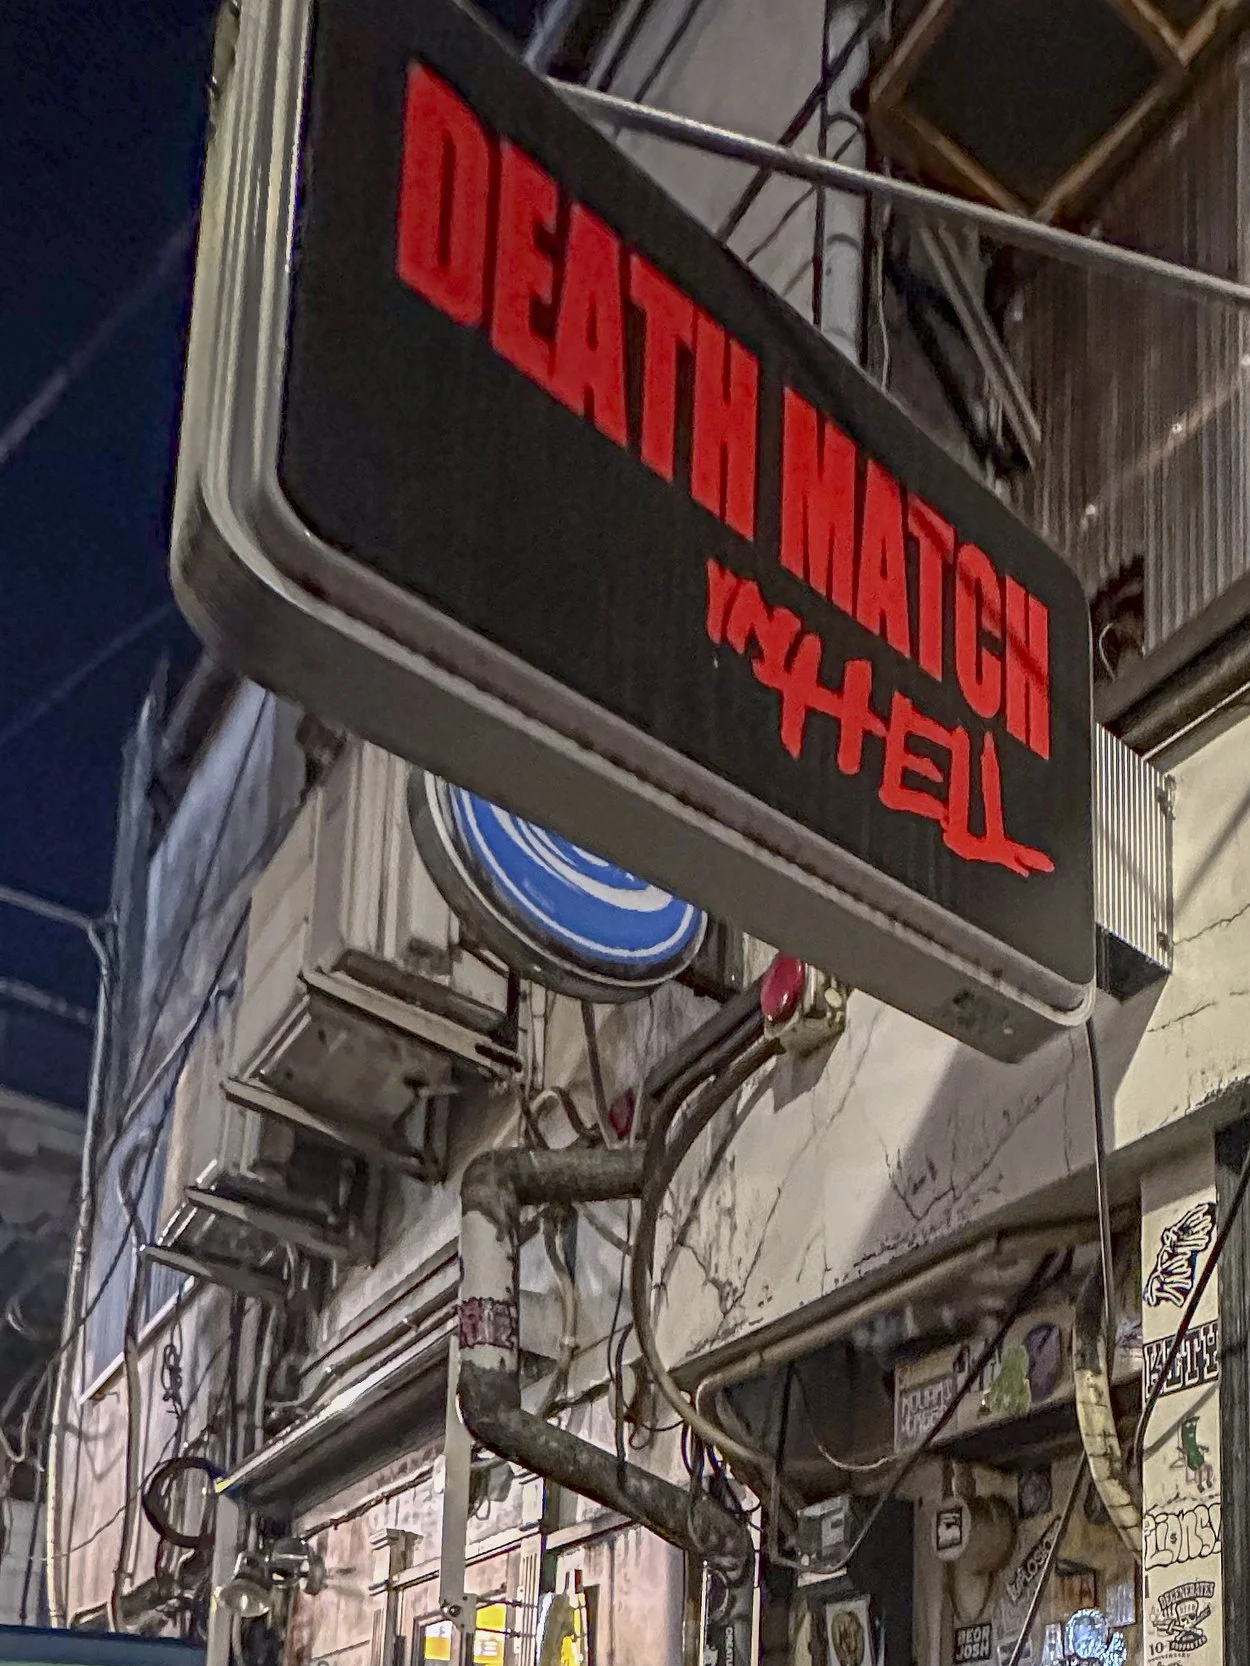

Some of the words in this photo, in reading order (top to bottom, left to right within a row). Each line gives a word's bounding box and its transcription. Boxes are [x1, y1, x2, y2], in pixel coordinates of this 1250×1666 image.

[397, 60, 760, 541] DEATH
[780, 386, 1050, 760] MATCH
[780, 634, 1055, 877] HELL
